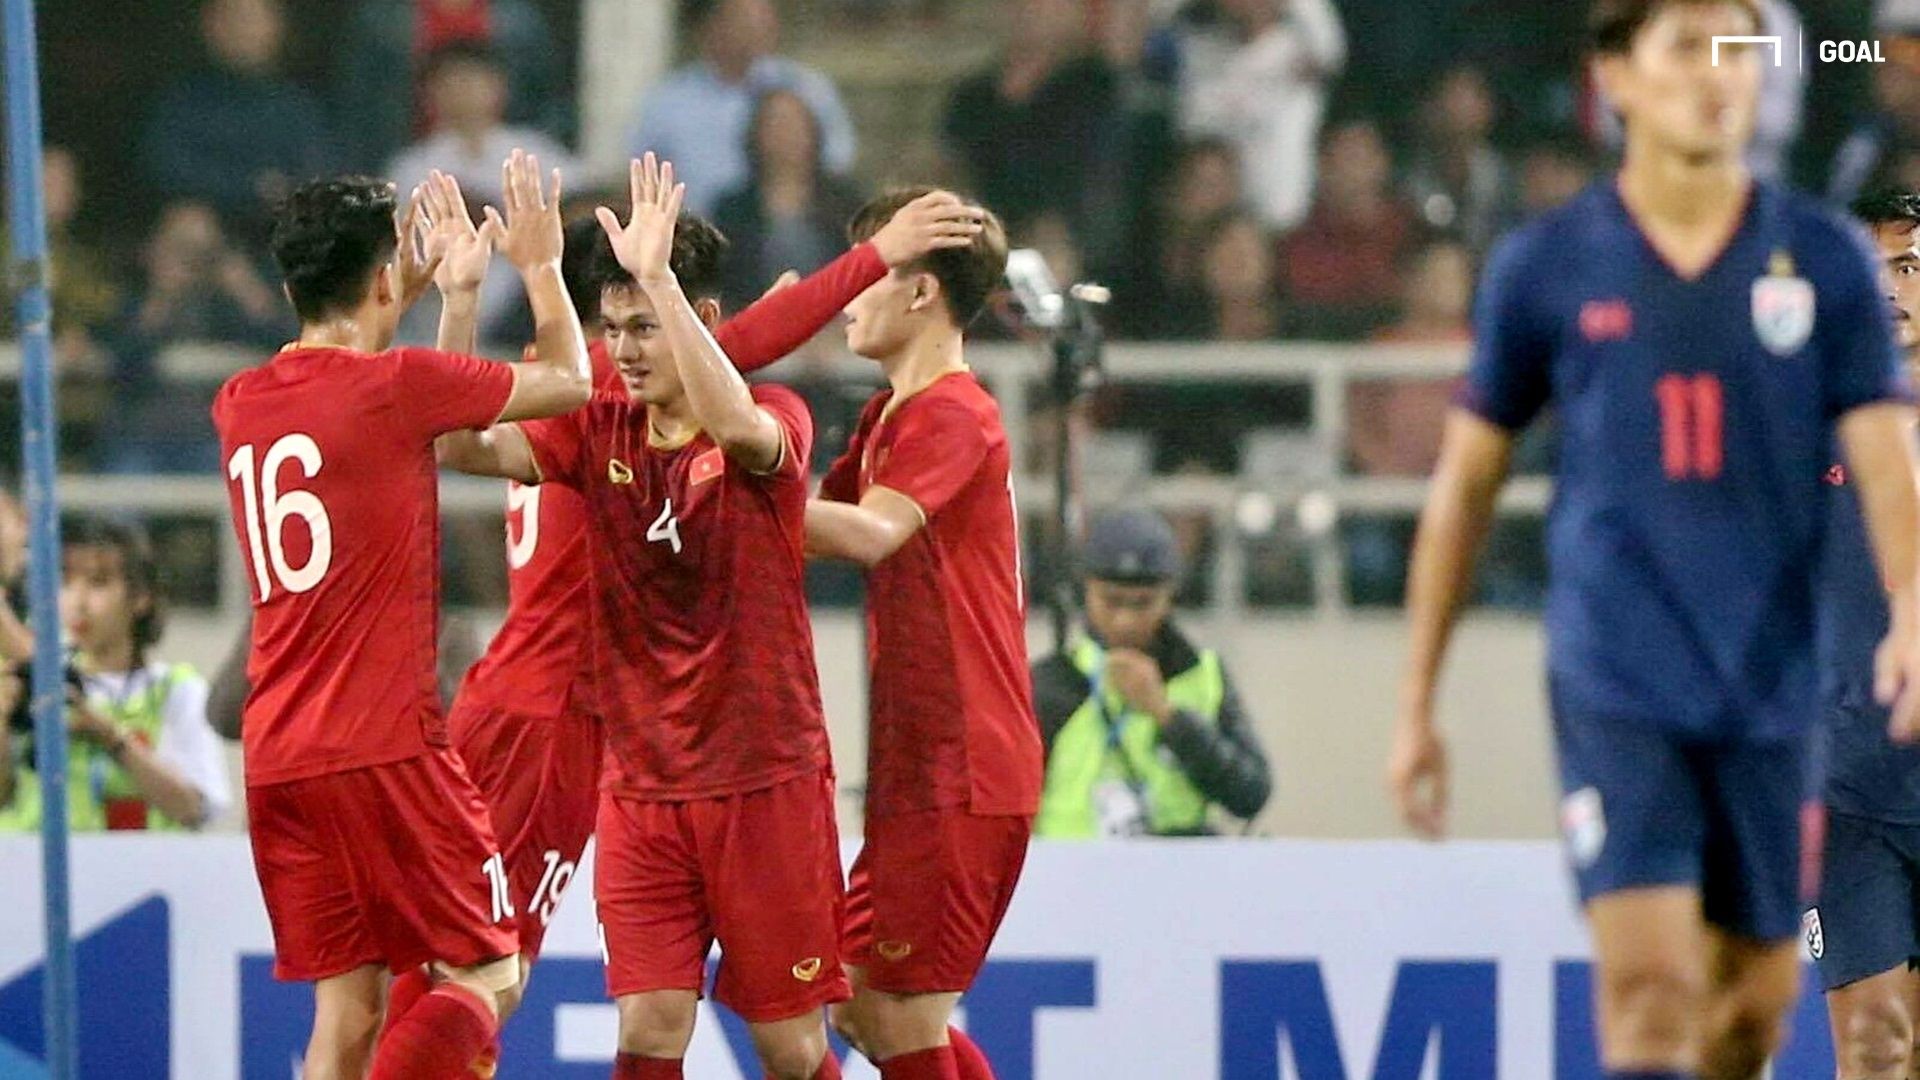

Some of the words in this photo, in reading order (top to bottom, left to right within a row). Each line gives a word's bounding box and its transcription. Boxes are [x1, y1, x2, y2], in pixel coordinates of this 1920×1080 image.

[1656, 371, 1723, 481] 11
[228, 433, 332, 603] 16
[646, 498, 682, 554] 4
[527, 850, 576, 926] 19
